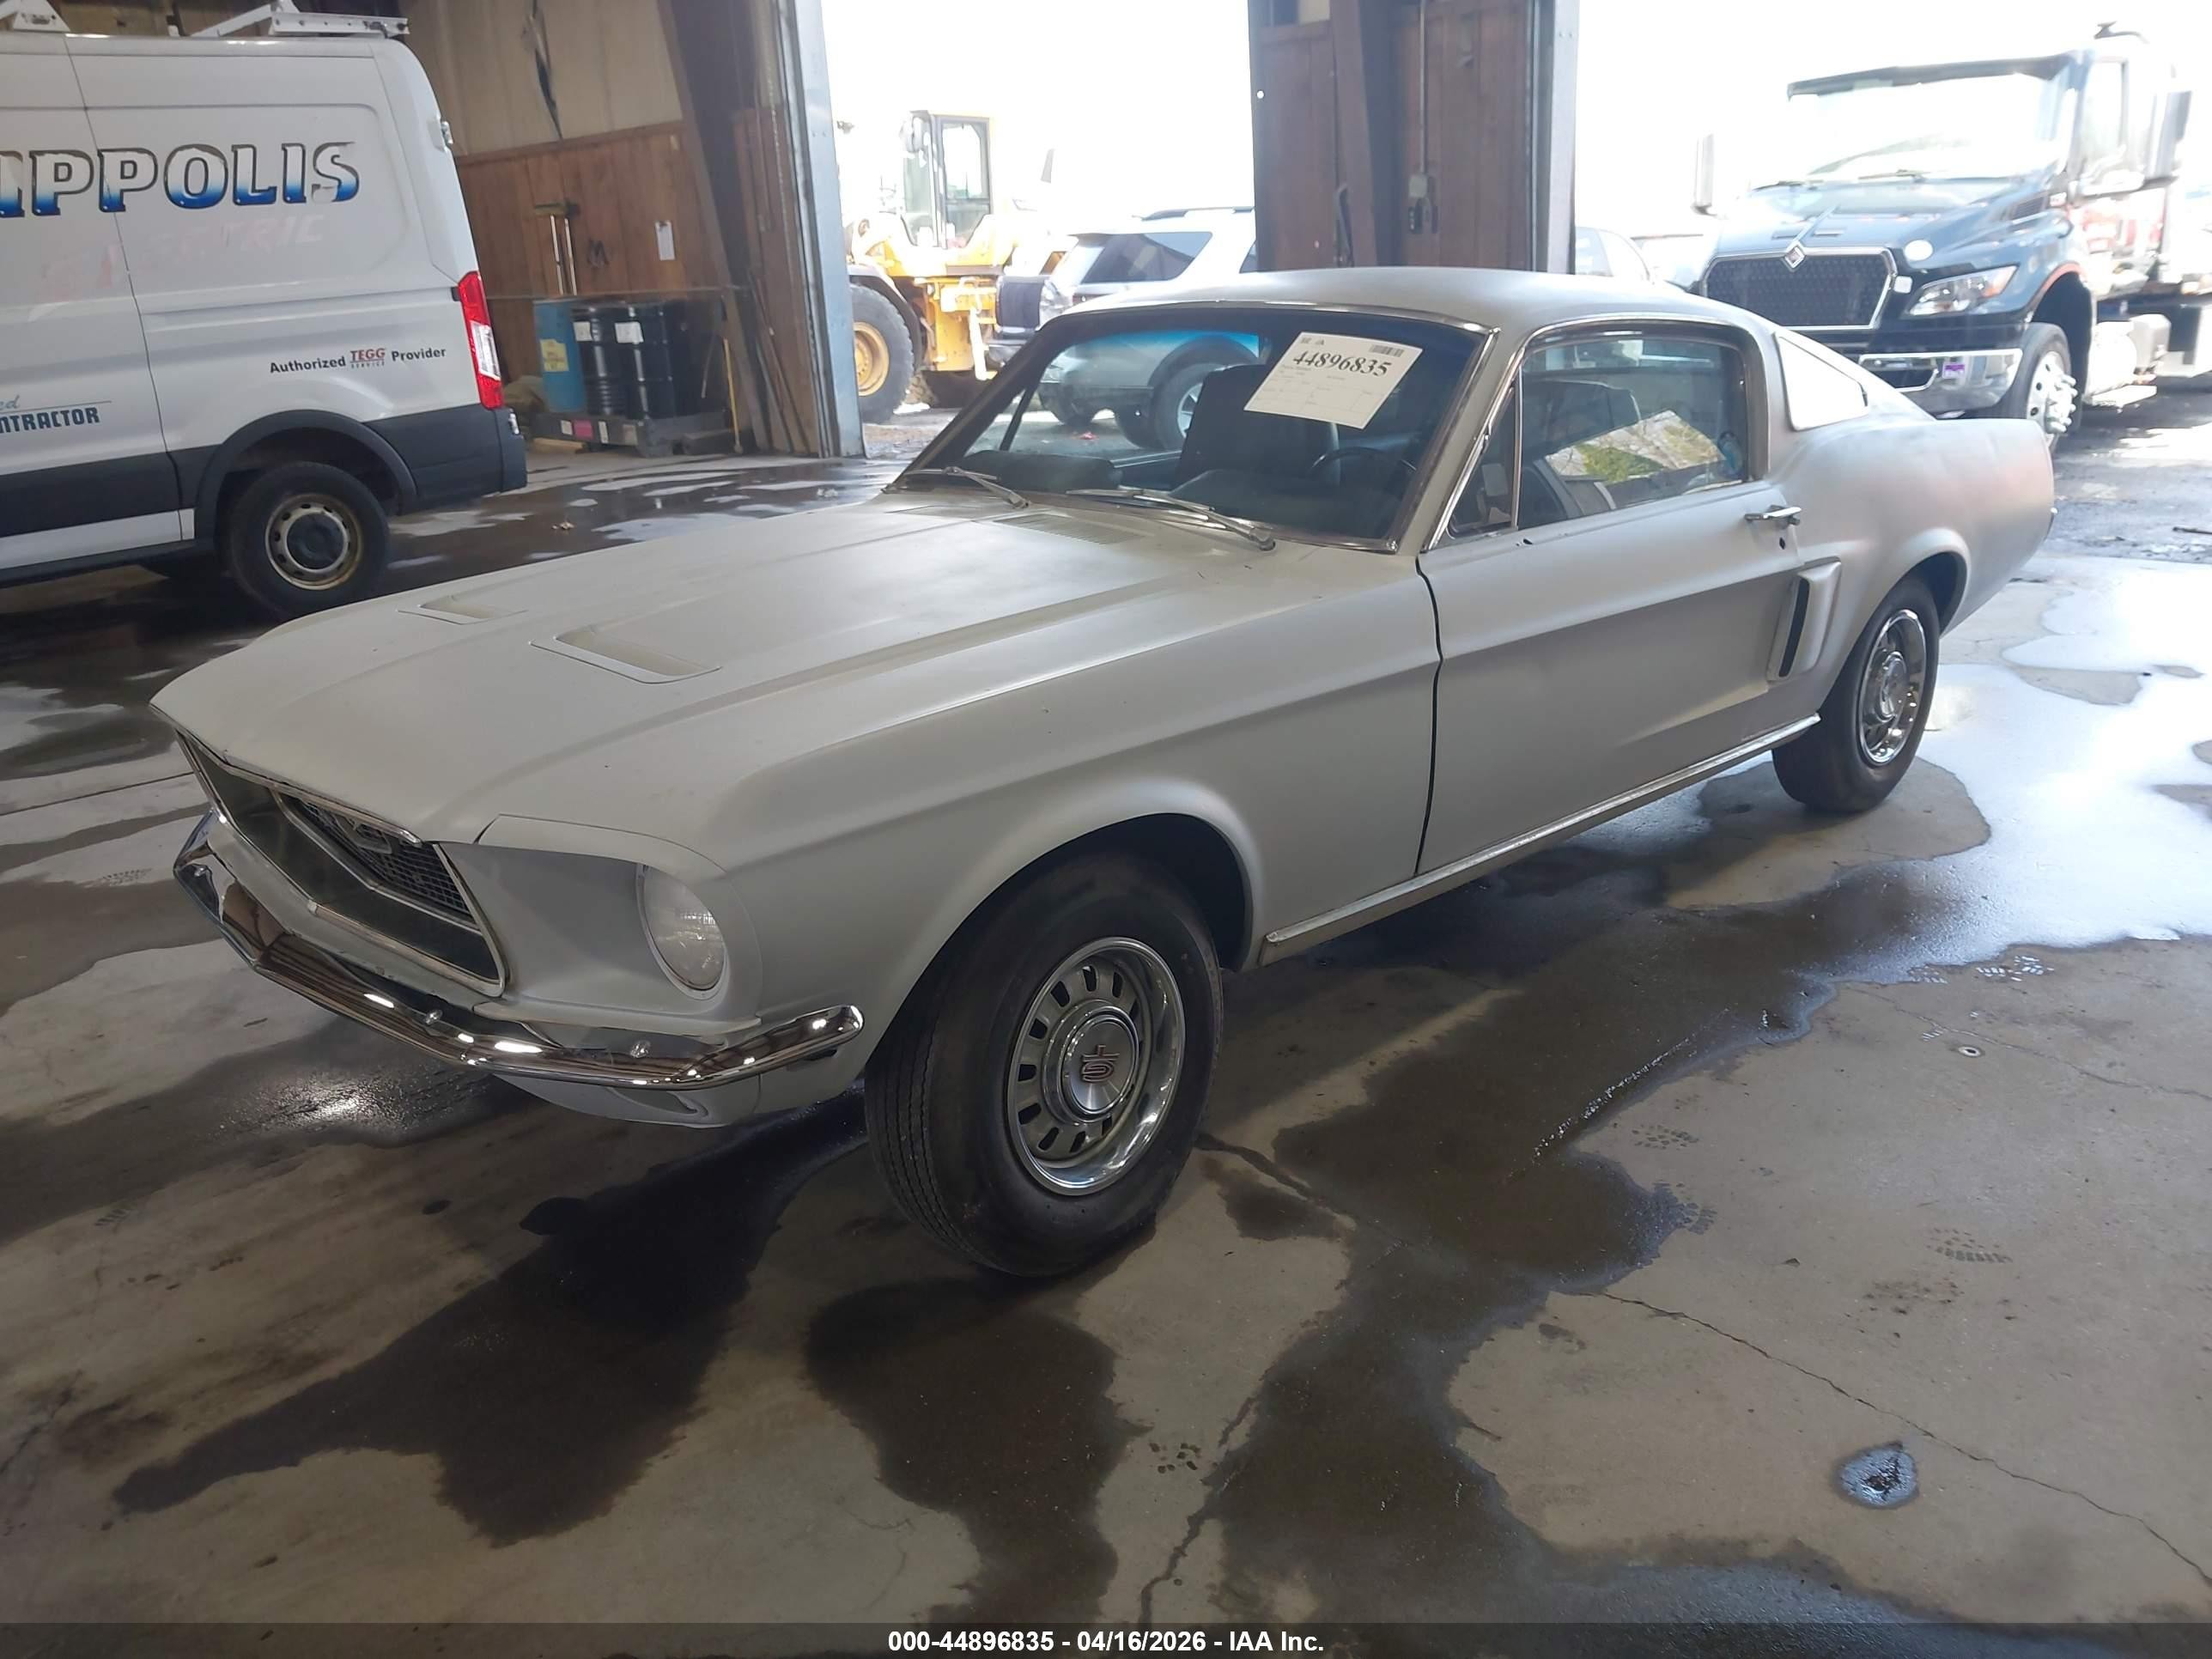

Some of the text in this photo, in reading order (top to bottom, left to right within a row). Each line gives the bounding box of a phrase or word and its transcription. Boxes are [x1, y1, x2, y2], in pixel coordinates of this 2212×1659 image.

[270, 348, 447, 374] Authorized TEGG Provider
[1293, 350, 1392, 376] 44896835
